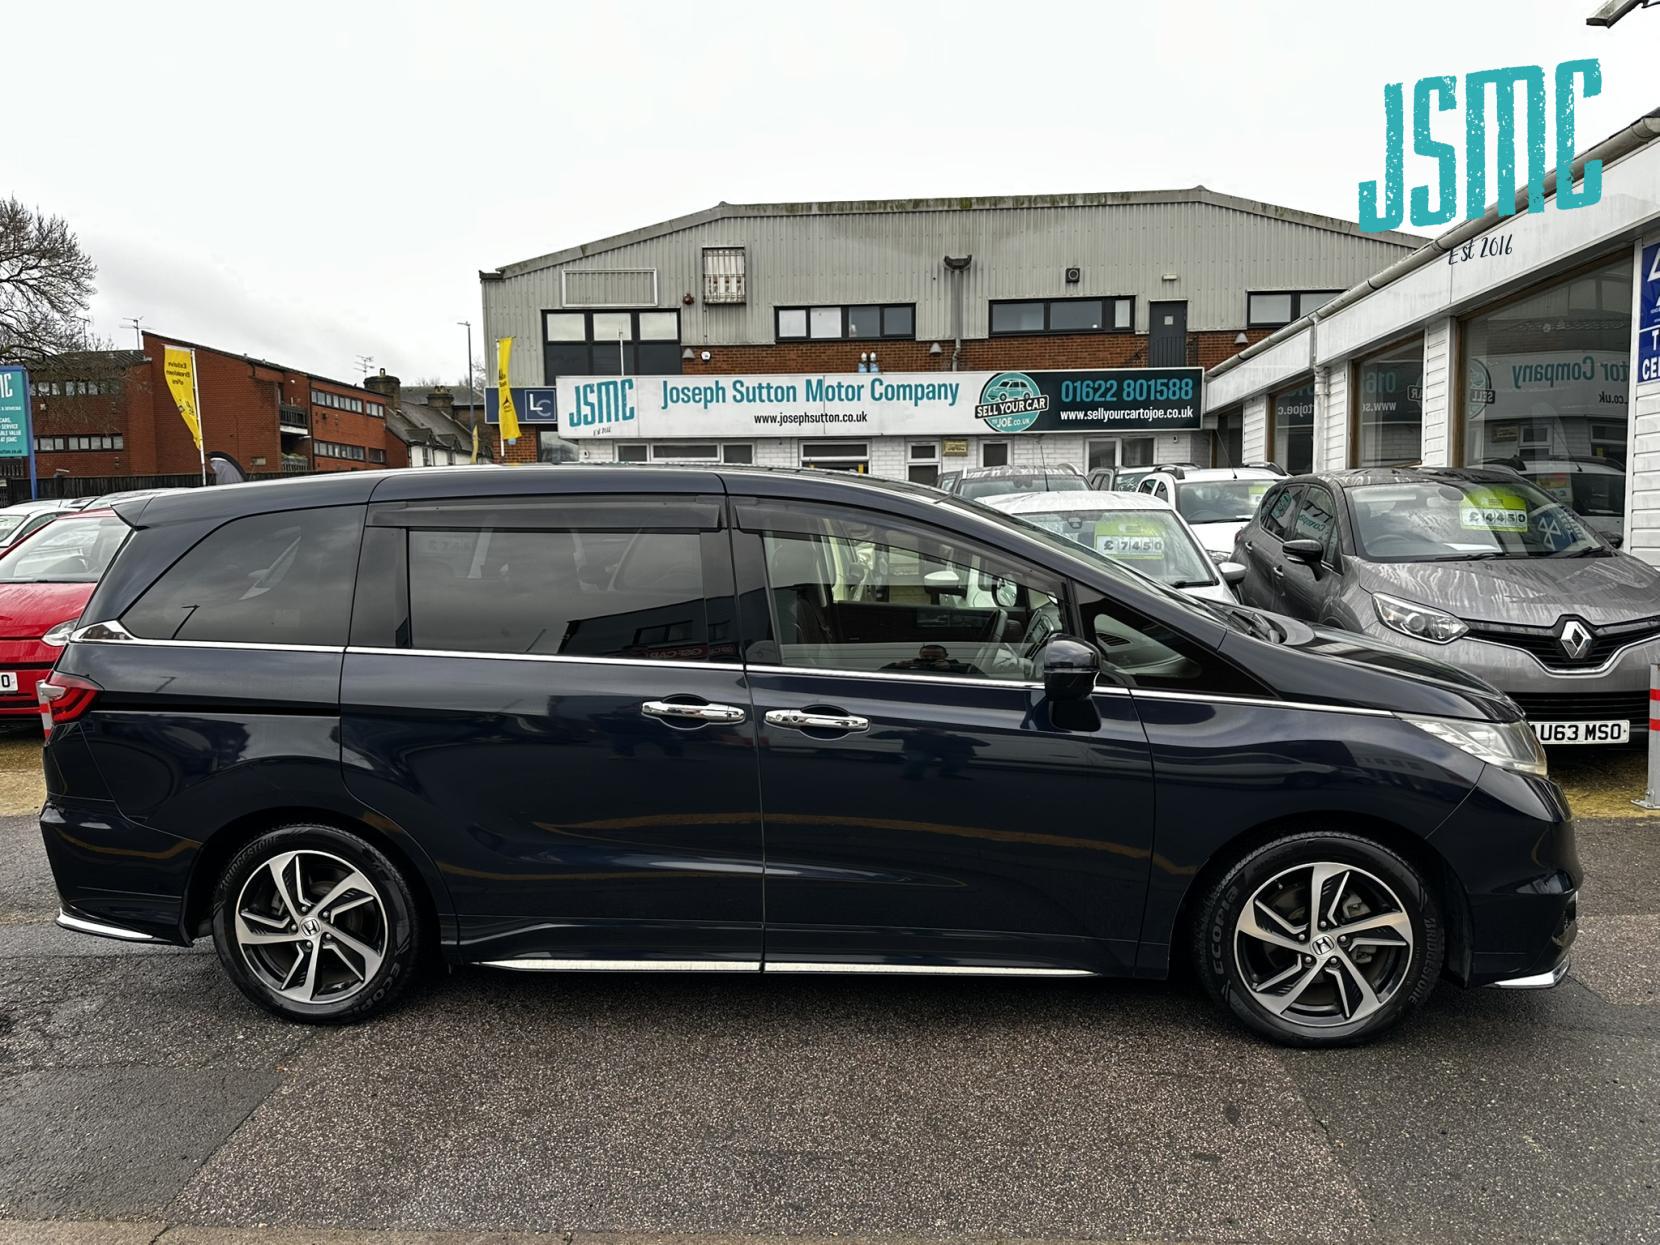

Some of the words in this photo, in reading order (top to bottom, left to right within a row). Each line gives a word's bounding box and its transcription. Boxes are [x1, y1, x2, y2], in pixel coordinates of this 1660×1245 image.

[661, 380, 726, 410] Joseph
[732, 379, 797, 403] Sutton
[805, 378, 865, 403] Motor
[870, 377, 960, 407] Company
[1061, 380, 1118, 402] 01622
[1122, 378, 1193, 401] 801588
[568, 378, 635, 427] JSMC
[976, 404, 999, 417] SELL
[1000, 400, 1025, 414] YOUR
[1026, 398, 1046, 410] CAR
[754, 411, 868, 426] www.josephsutton.co.uk
[1060, 406, 1193, 422] www.sellyourcartojoe.co.uk
[1584, 723, 1621, 741] MSO
